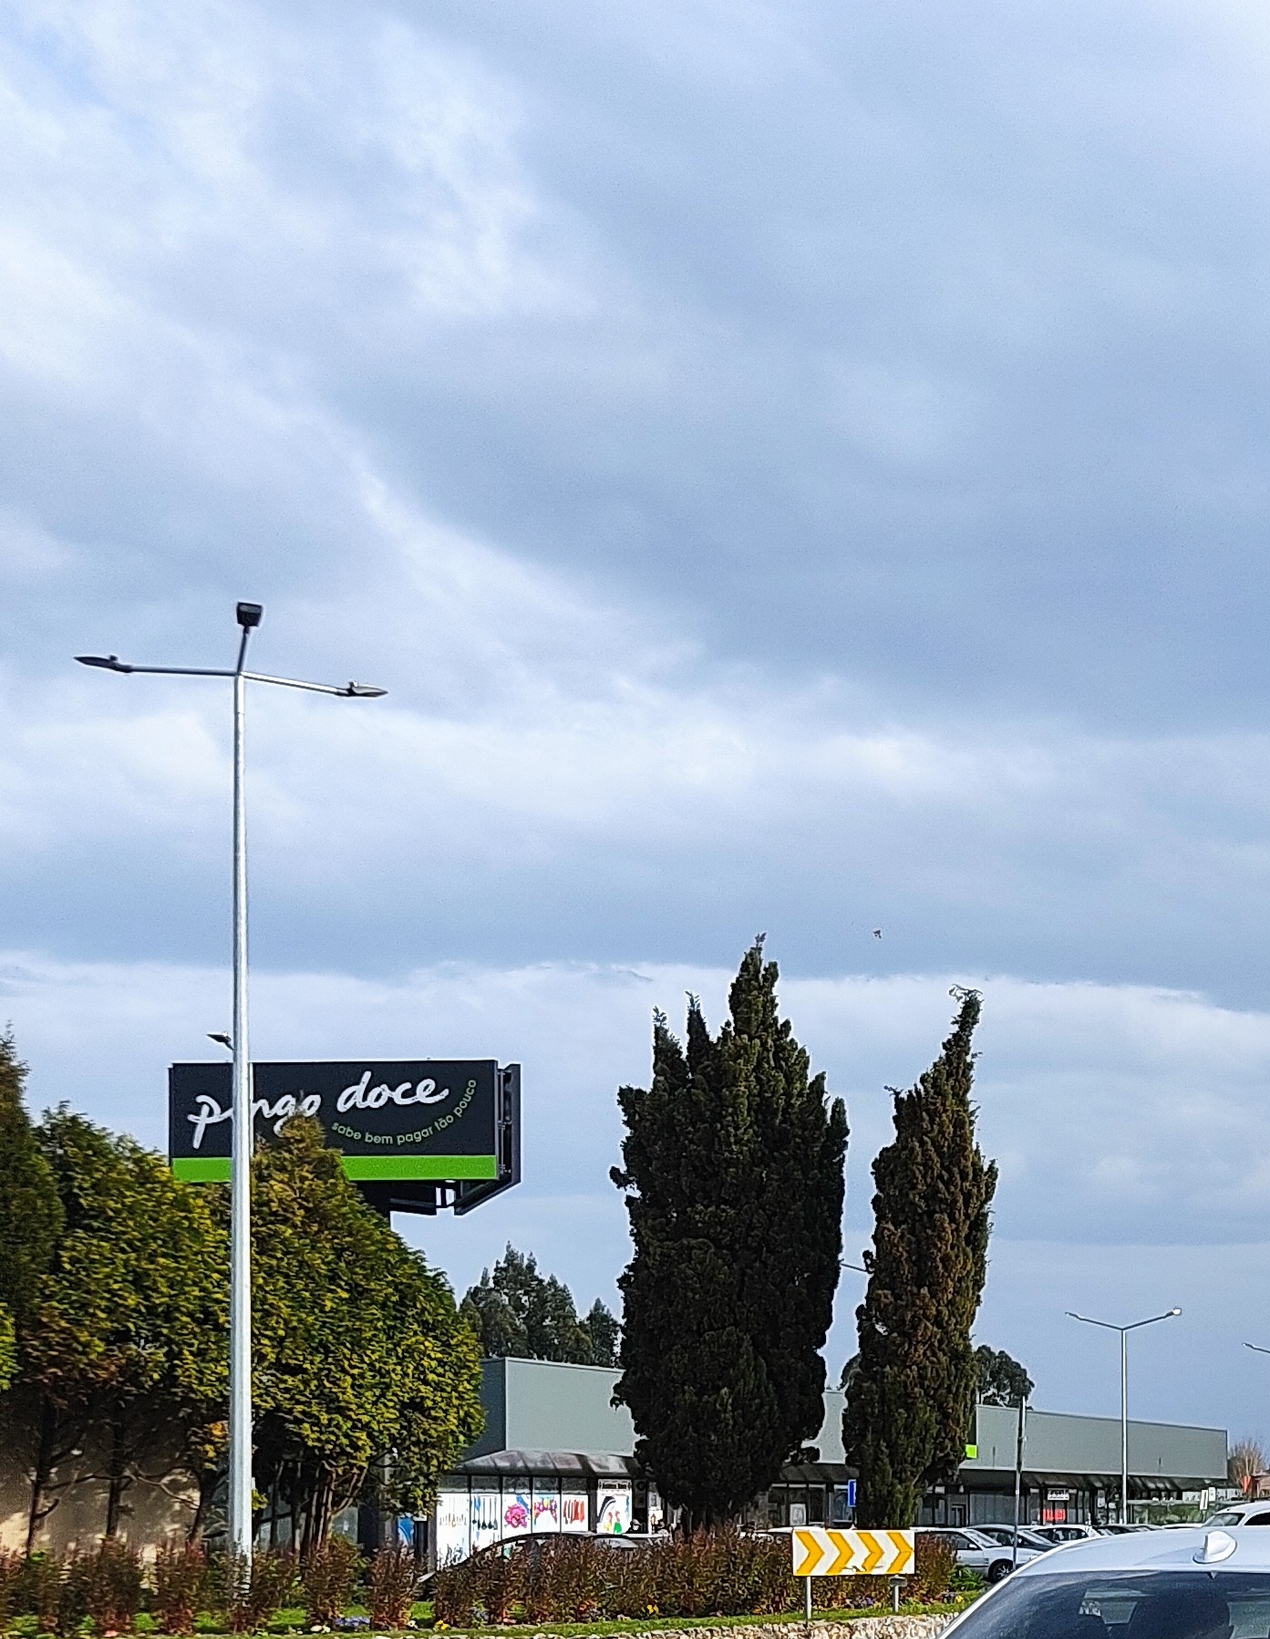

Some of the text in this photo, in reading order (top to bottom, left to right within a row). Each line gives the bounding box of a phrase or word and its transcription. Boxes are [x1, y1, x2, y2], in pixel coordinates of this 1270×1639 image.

[187, 1070, 450, 1149] pngo doce
[331, 1079, 477, 1146] sabe bem pagar tão pouco
